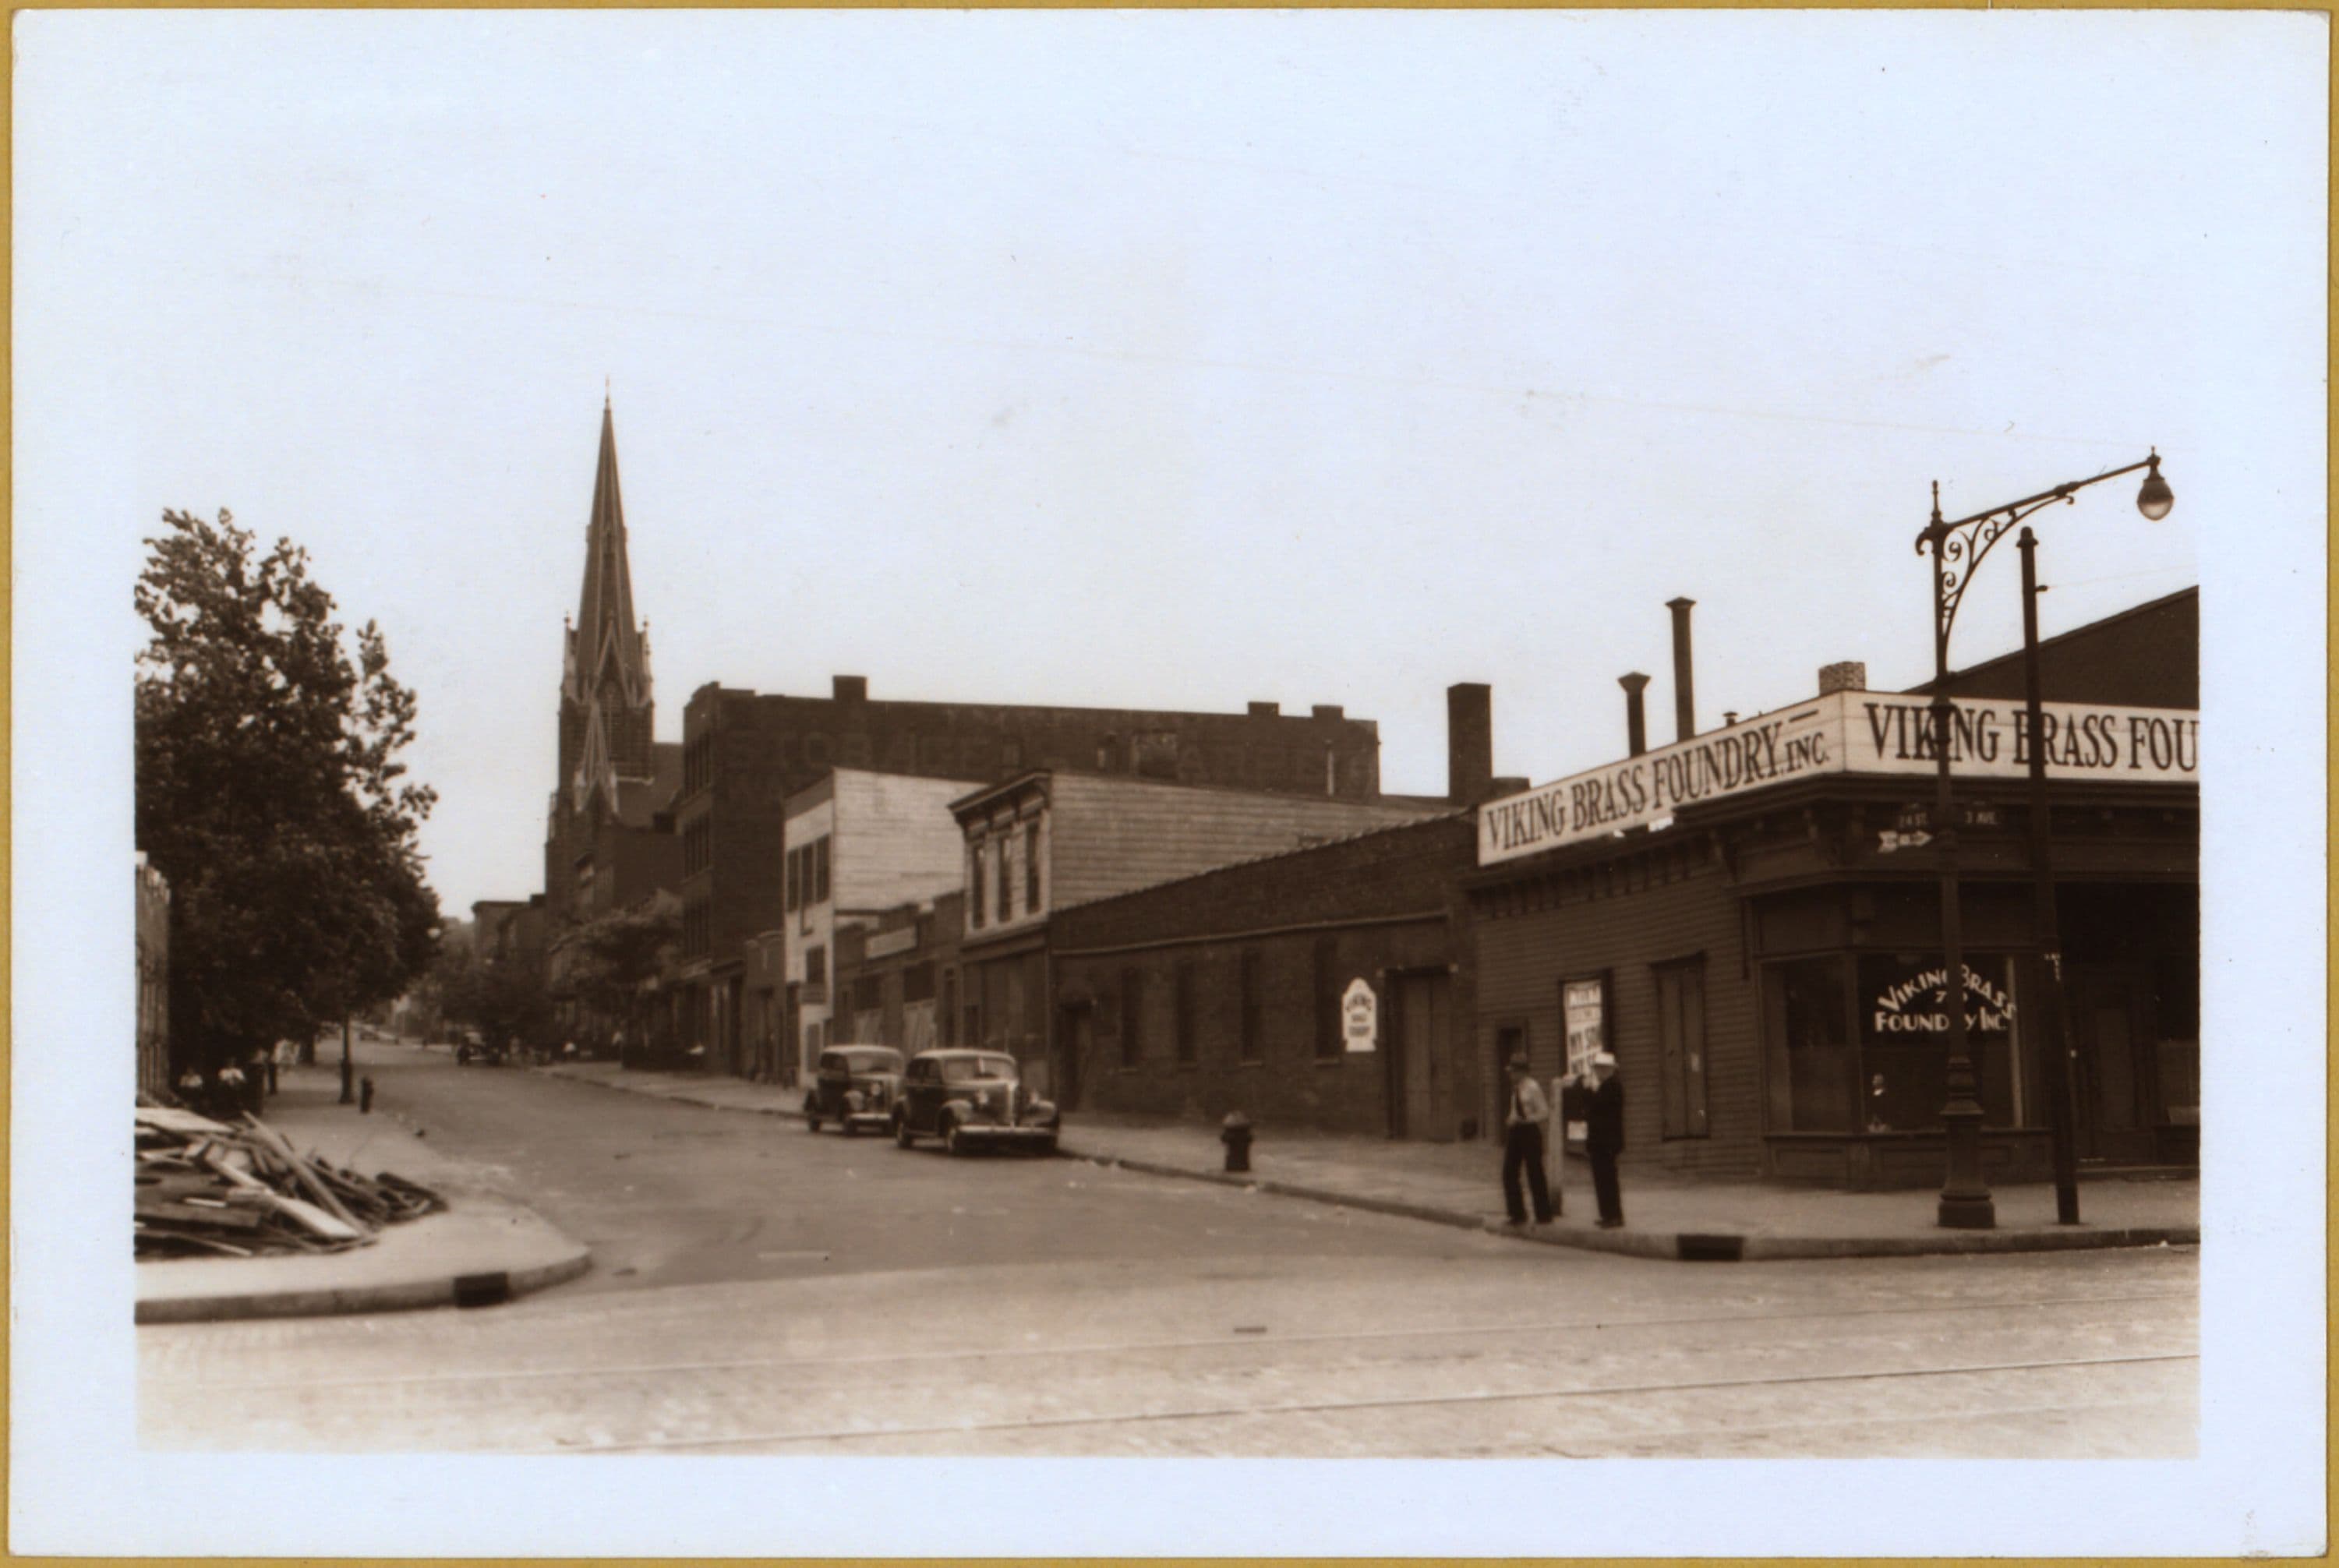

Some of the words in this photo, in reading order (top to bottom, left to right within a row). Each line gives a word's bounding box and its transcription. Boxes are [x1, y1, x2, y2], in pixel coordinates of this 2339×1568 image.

[1864, 703, 2001, 762] VIKNG
[2011, 710, 2118, 768] BRASS
[2128, 717, 2200, 772] FOU
[1486, 789, 1566, 850] VIKING
[1571, 765, 1647, 832] BRASS
[1874, 1011, 1977, 1032] FOUNDY
